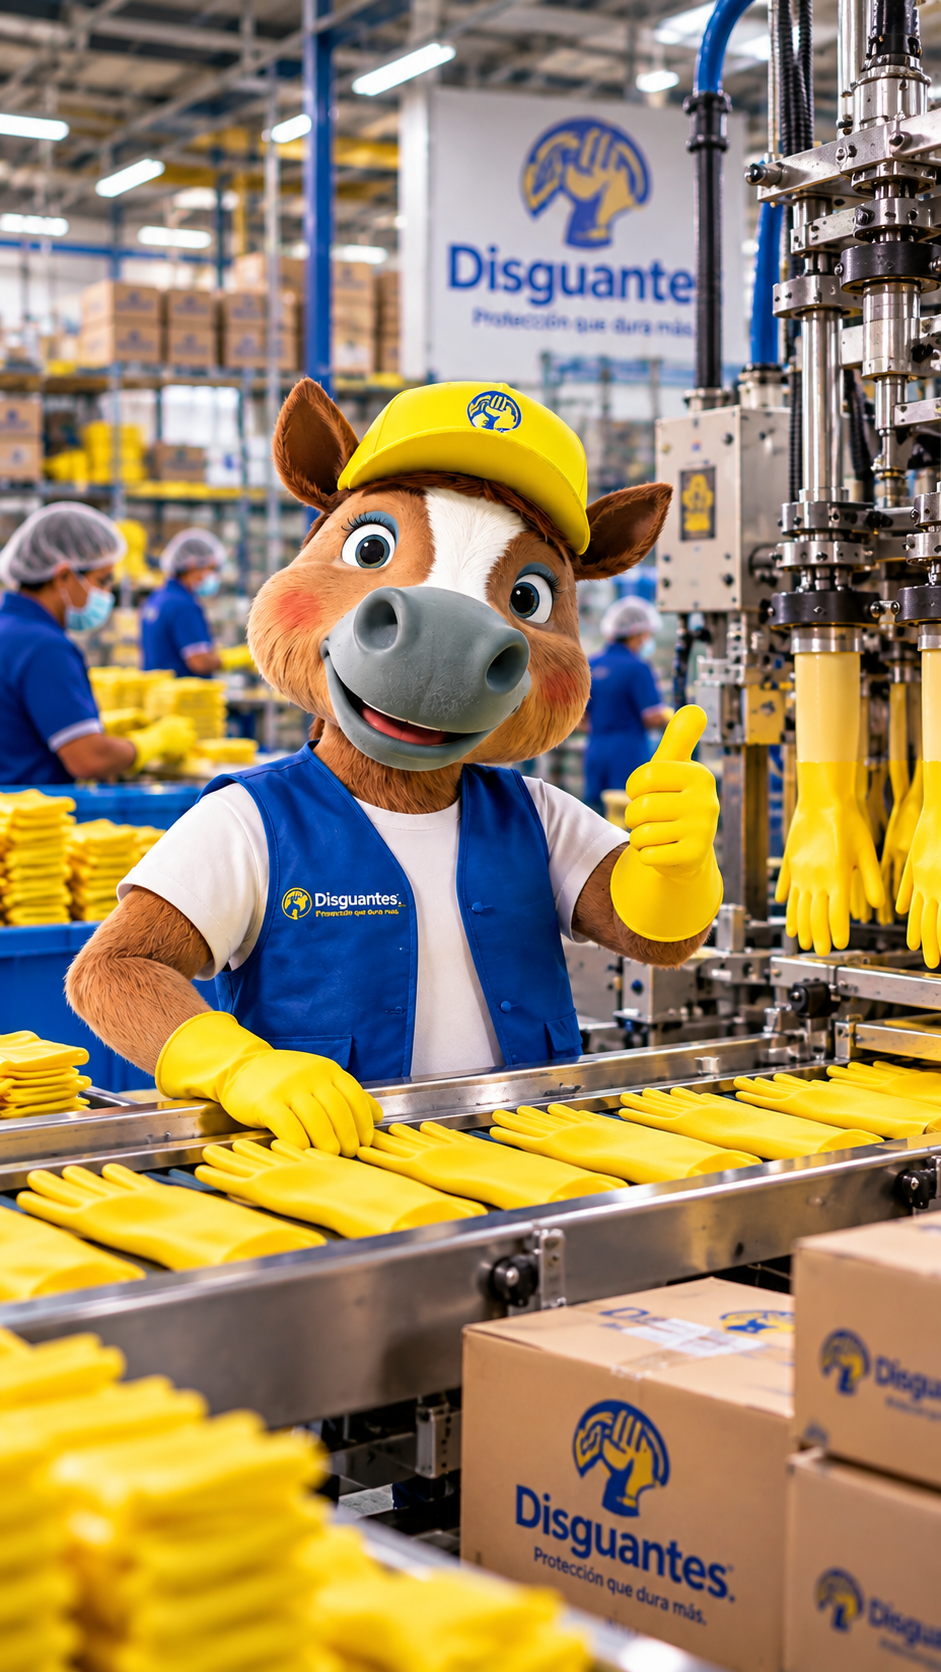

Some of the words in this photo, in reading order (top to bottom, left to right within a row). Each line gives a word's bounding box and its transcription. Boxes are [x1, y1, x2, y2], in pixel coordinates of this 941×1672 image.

[448, 244, 697, 306] Disguante
[575, 316, 606, 336] que
[613, 314, 652, 337] dura
[534, 1546, 604, 1588] Protección
[607, 1577, 633, 1596] que
[636, 1586, 670, 1612] dura
[672, 1602, 708, 1627] más.
